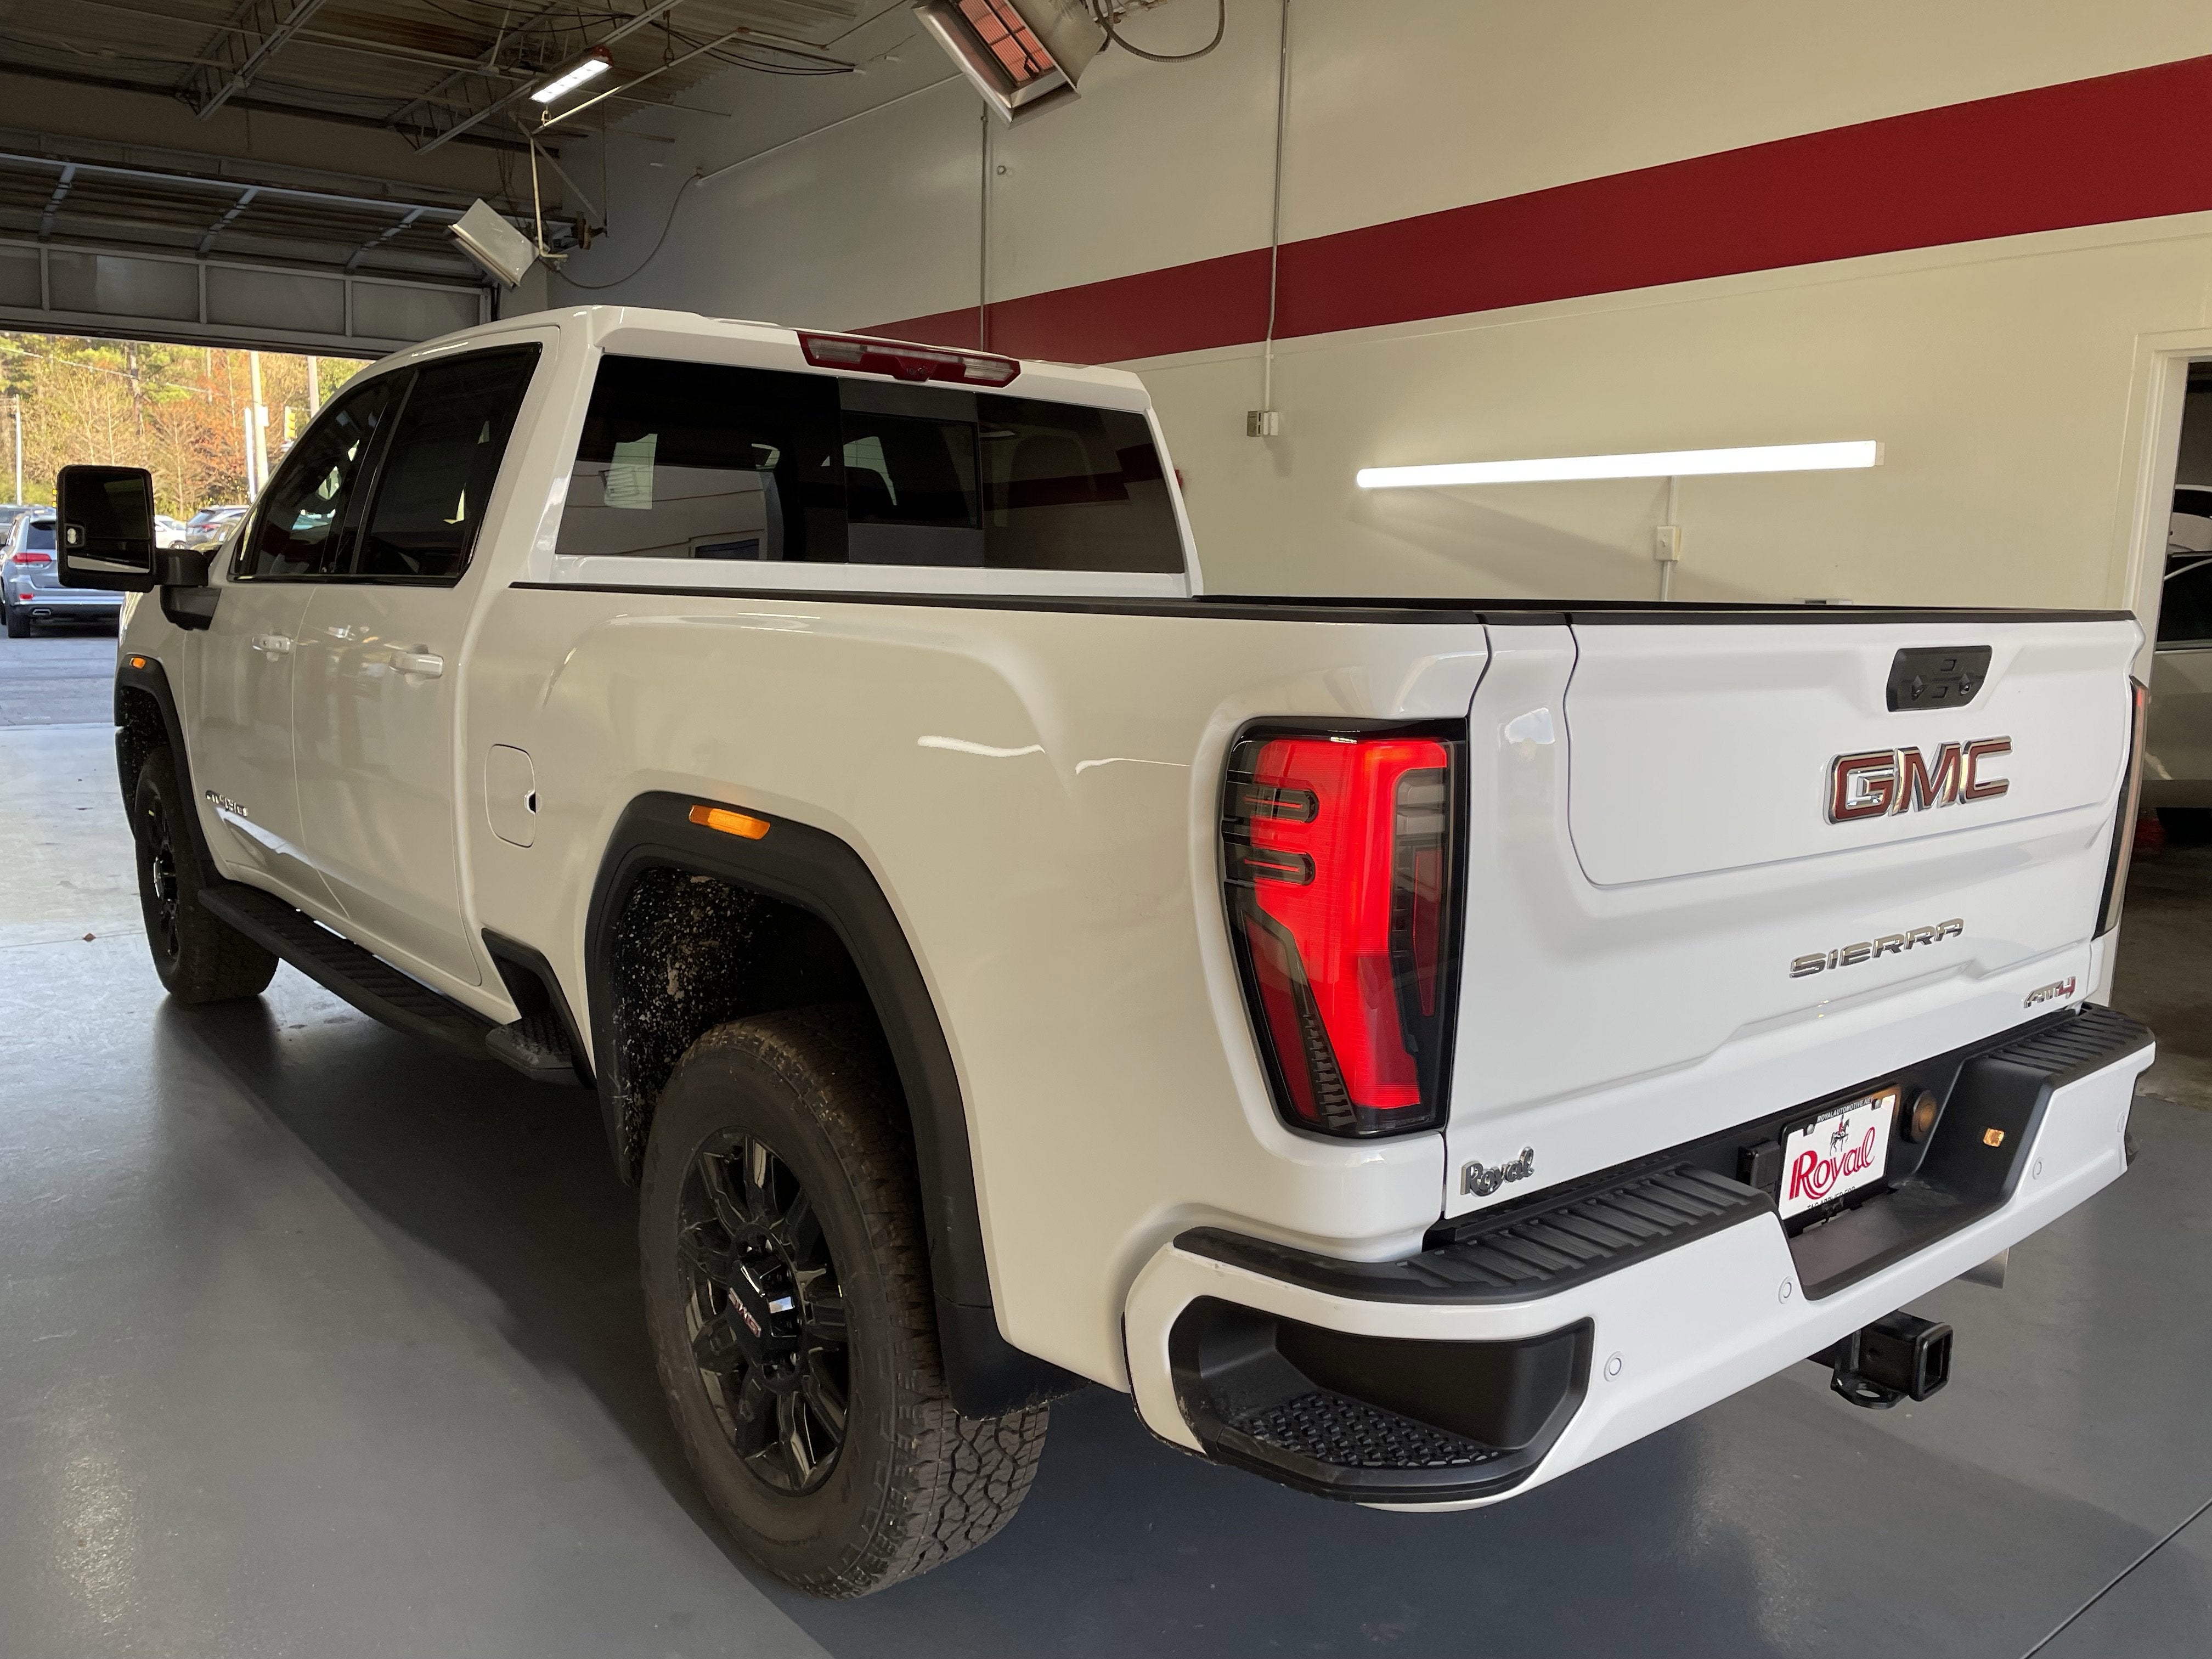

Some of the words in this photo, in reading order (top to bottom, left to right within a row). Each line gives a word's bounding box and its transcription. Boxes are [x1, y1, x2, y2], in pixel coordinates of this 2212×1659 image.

[1824, 735, 2013, 825] GMC
[1790, 918, 1963, 978] SIERRA
[2024, 976, 2076, 1008] AT4
[1460, 1146, 1535, 1197] Royal
[1788, 1126, 1876, 1201] Royal
